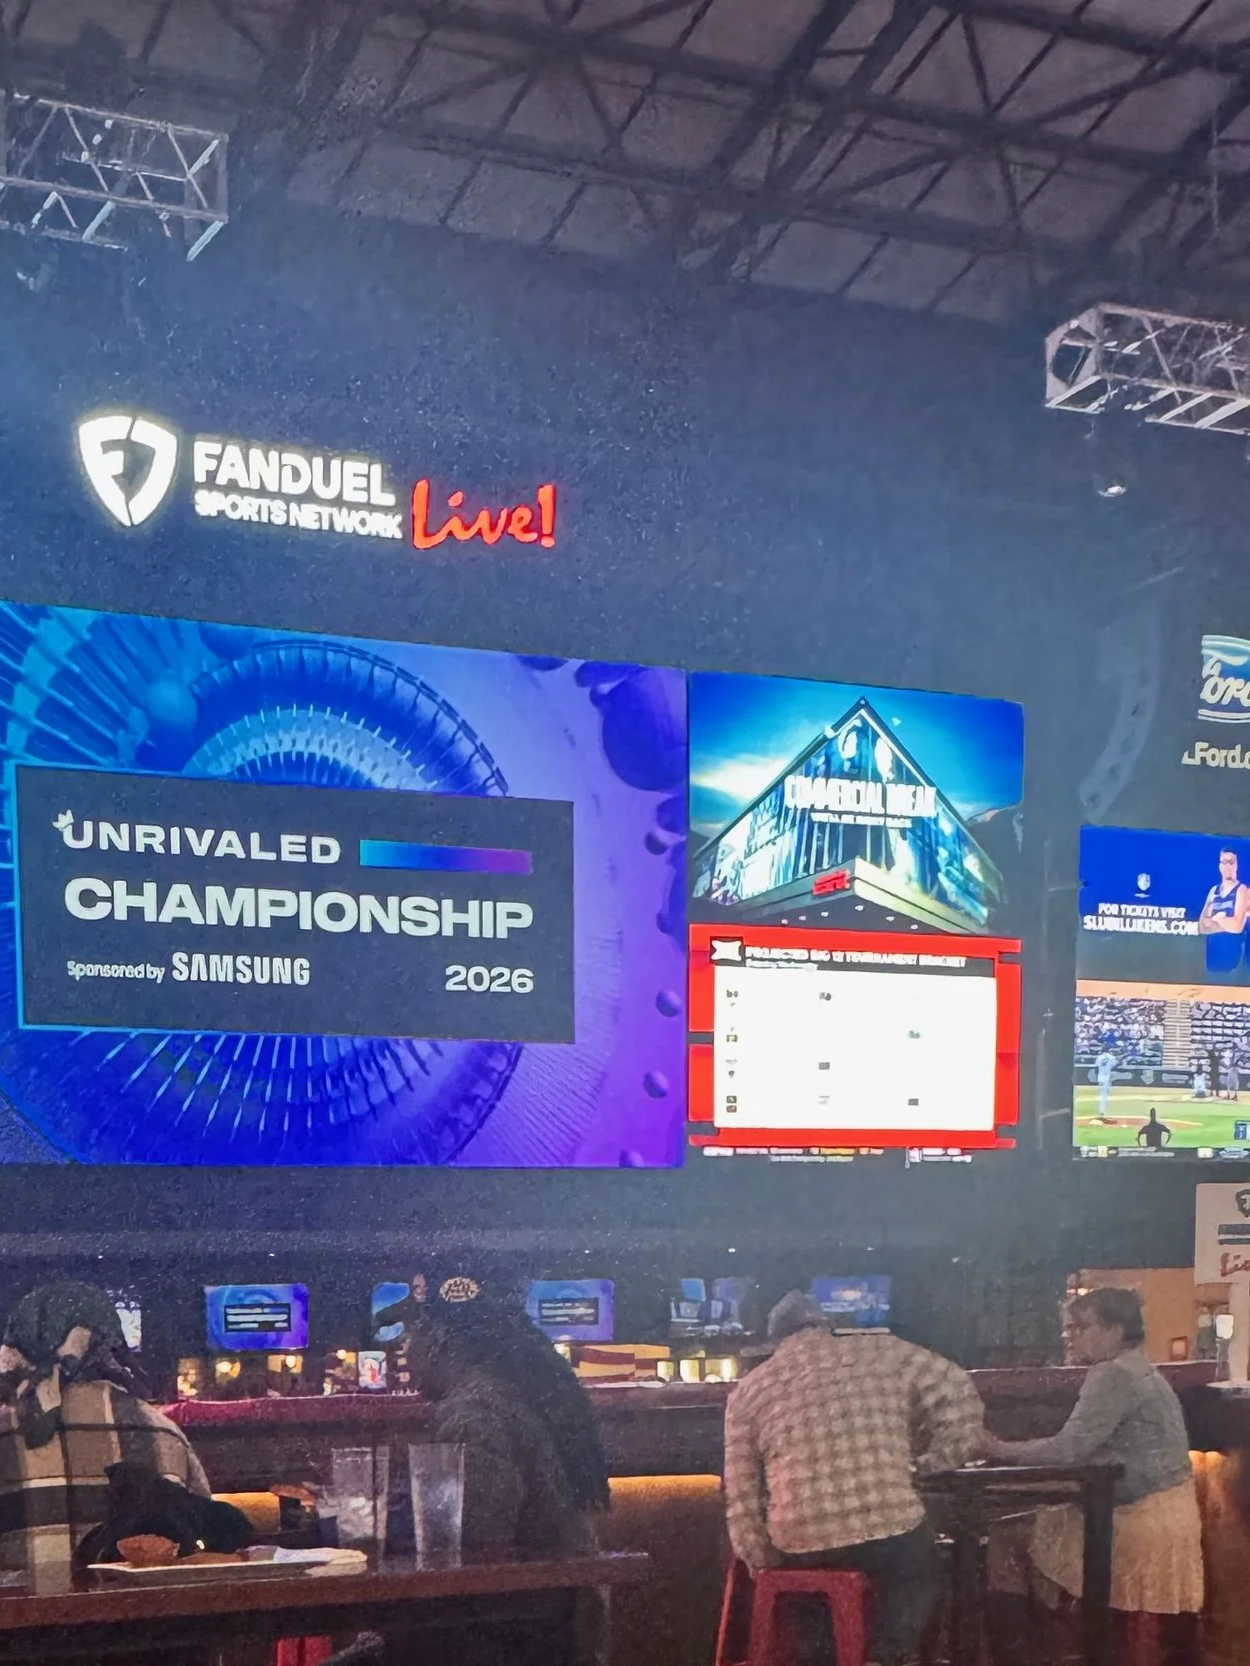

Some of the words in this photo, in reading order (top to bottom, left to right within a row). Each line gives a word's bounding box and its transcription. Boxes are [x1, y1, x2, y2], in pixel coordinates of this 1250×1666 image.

[193, 440, 396, 507] FANDUEL
[194, 490, 288, 527] SPORTS
[289, 501, 403, 540] NETWORK
[411, 478, 555, 550] Live!
[61, 818, 342, 865] UNRIVALED
[64, 877, 534, 940] CHAMPIONSHIP
[67, 960, 144, 981] Sponsored
[146, 963, 165, 983] by
[171, 952, 310, 985] SAMSUNG
[445, 965, 534, 994] 2026
